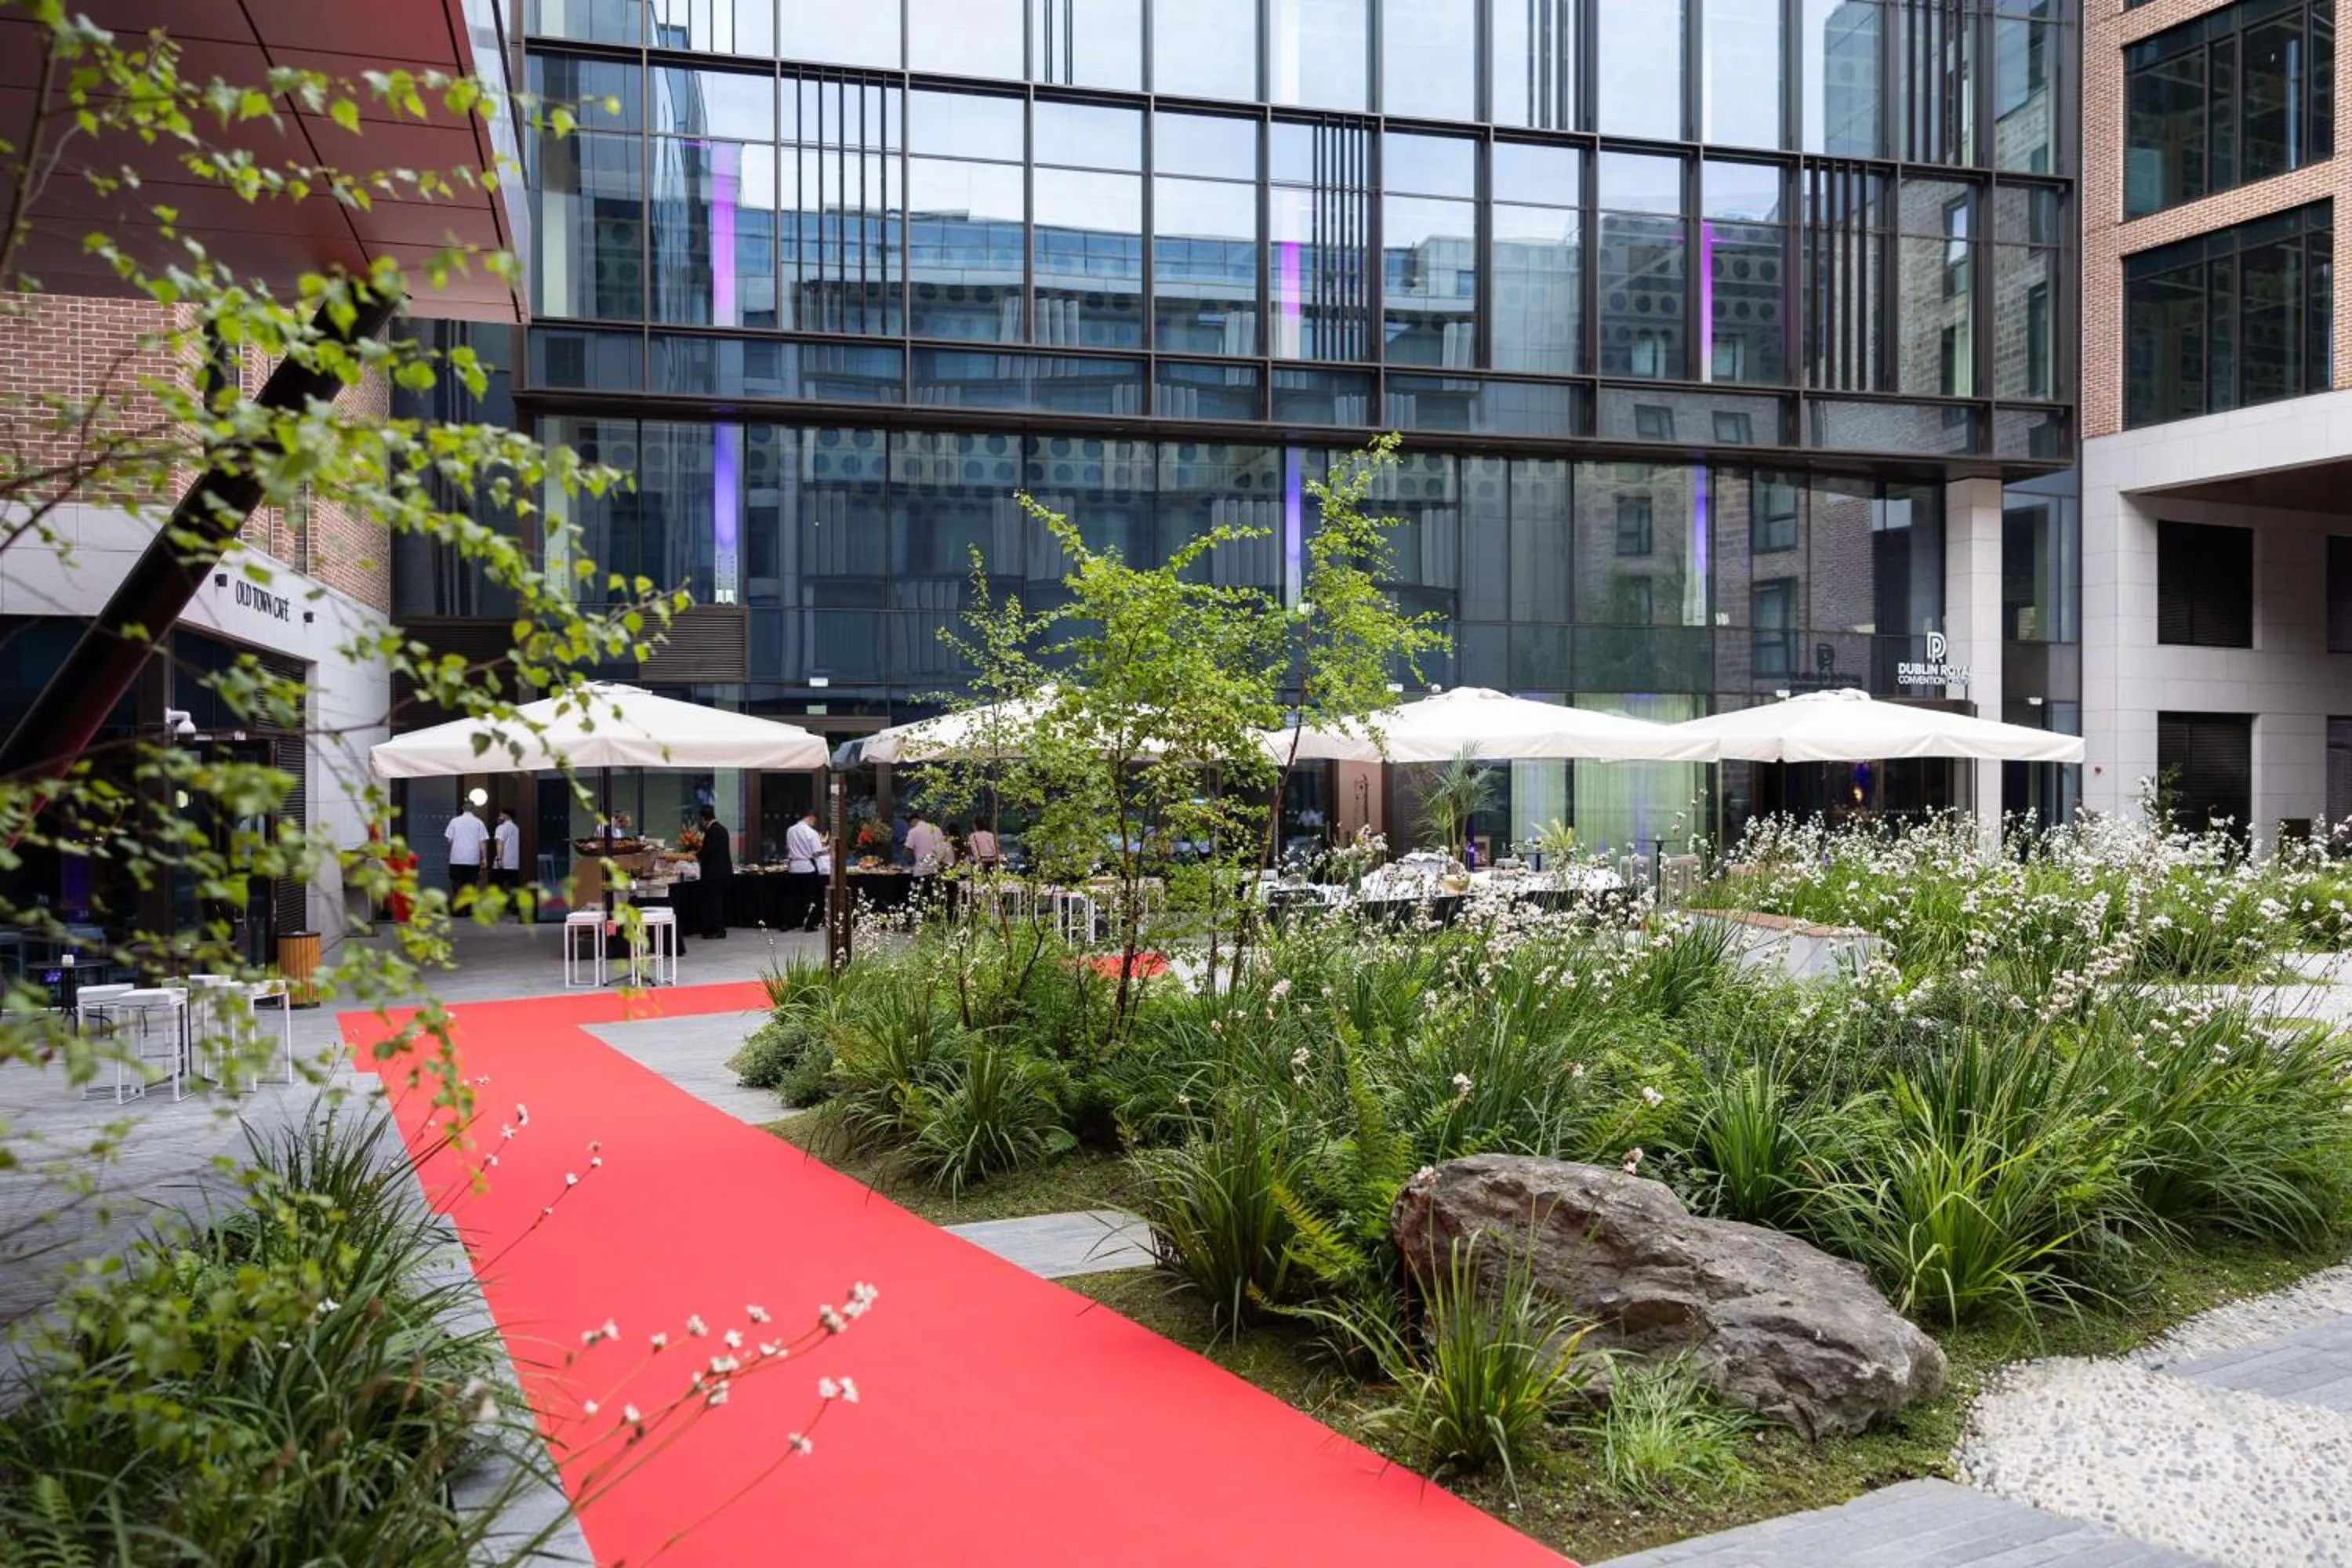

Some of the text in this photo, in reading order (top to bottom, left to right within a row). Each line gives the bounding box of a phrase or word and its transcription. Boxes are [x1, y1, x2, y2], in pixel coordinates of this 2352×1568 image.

[236, 579, 252, 607] OLD
[252, 586, 272, 615] TOWN
[1898, 662, 1973, 677] DUBLIN ROYAL
[1898, 675, 1945, 684] CONVENTION
